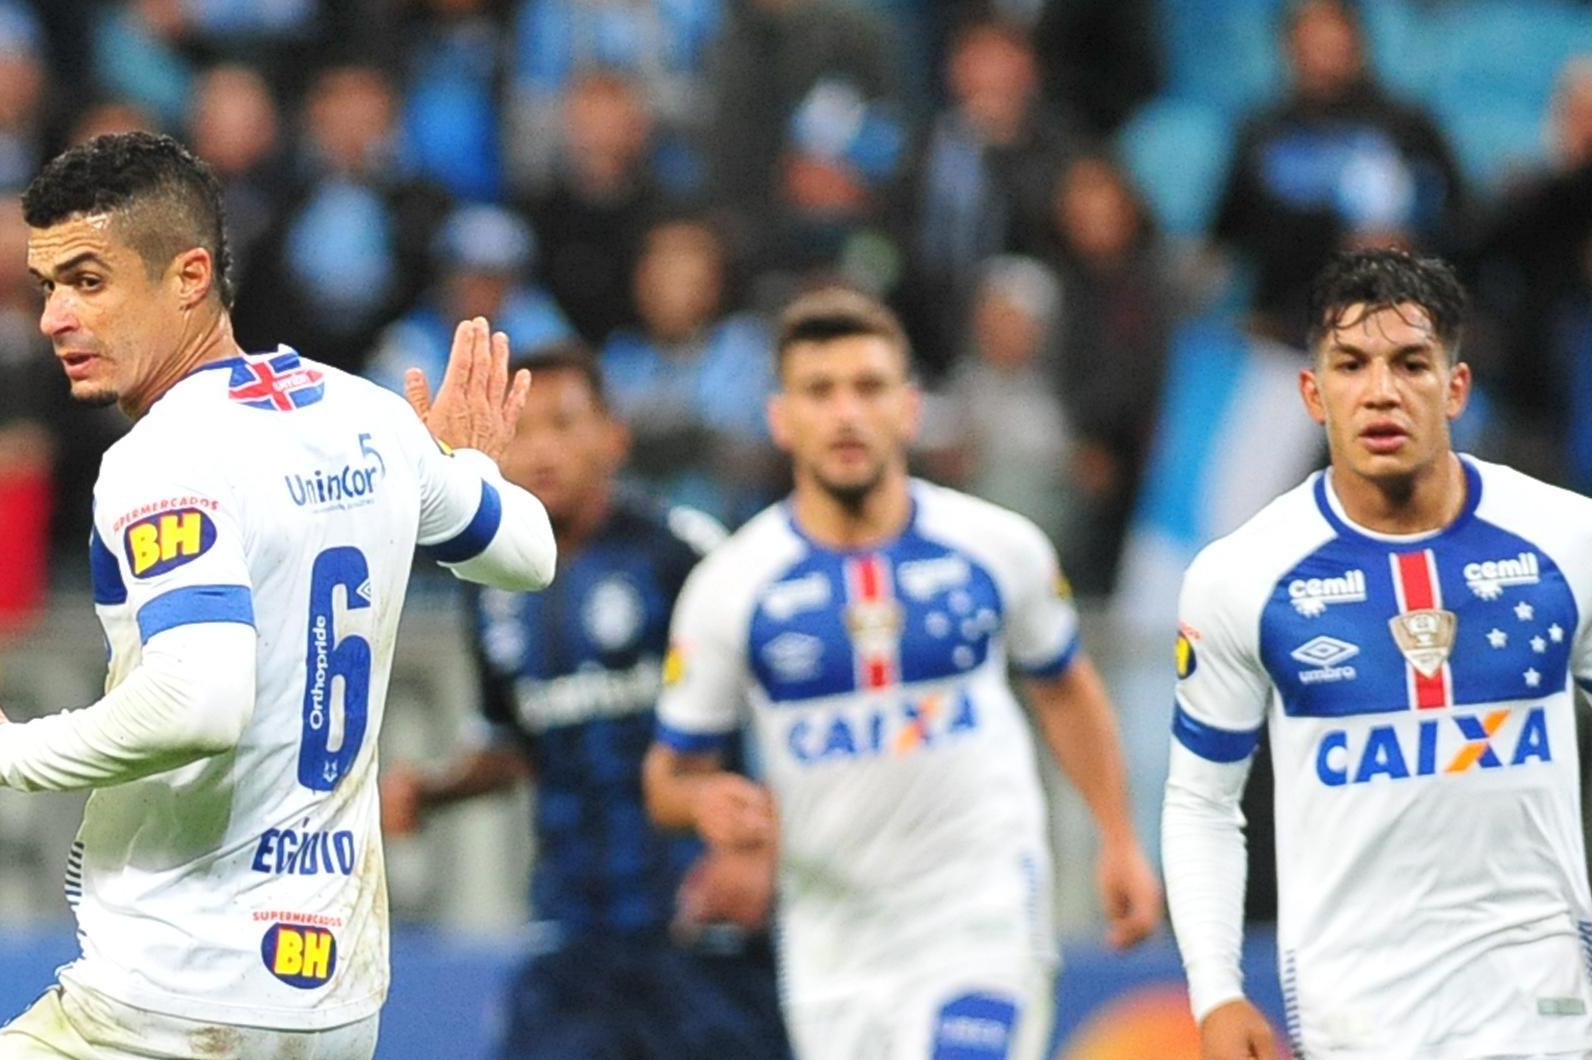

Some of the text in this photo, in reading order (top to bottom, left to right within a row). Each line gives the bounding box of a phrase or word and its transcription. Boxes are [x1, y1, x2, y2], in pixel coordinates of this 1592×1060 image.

[128, 511, 201, 576] BH
[1463, 551, 1540, 582] cemil
[1288, 568, 1366, 600] cemil
[298, 545, 371, 792] 6
[309, 613, 330, 731] Orthopride
[1297, 663, 1358, 686] umbro
[786, 688, 979, 768] CAIXA
[1315, 706, 1552, 788] CAIXA
[272, 928, 333, 979] BH
